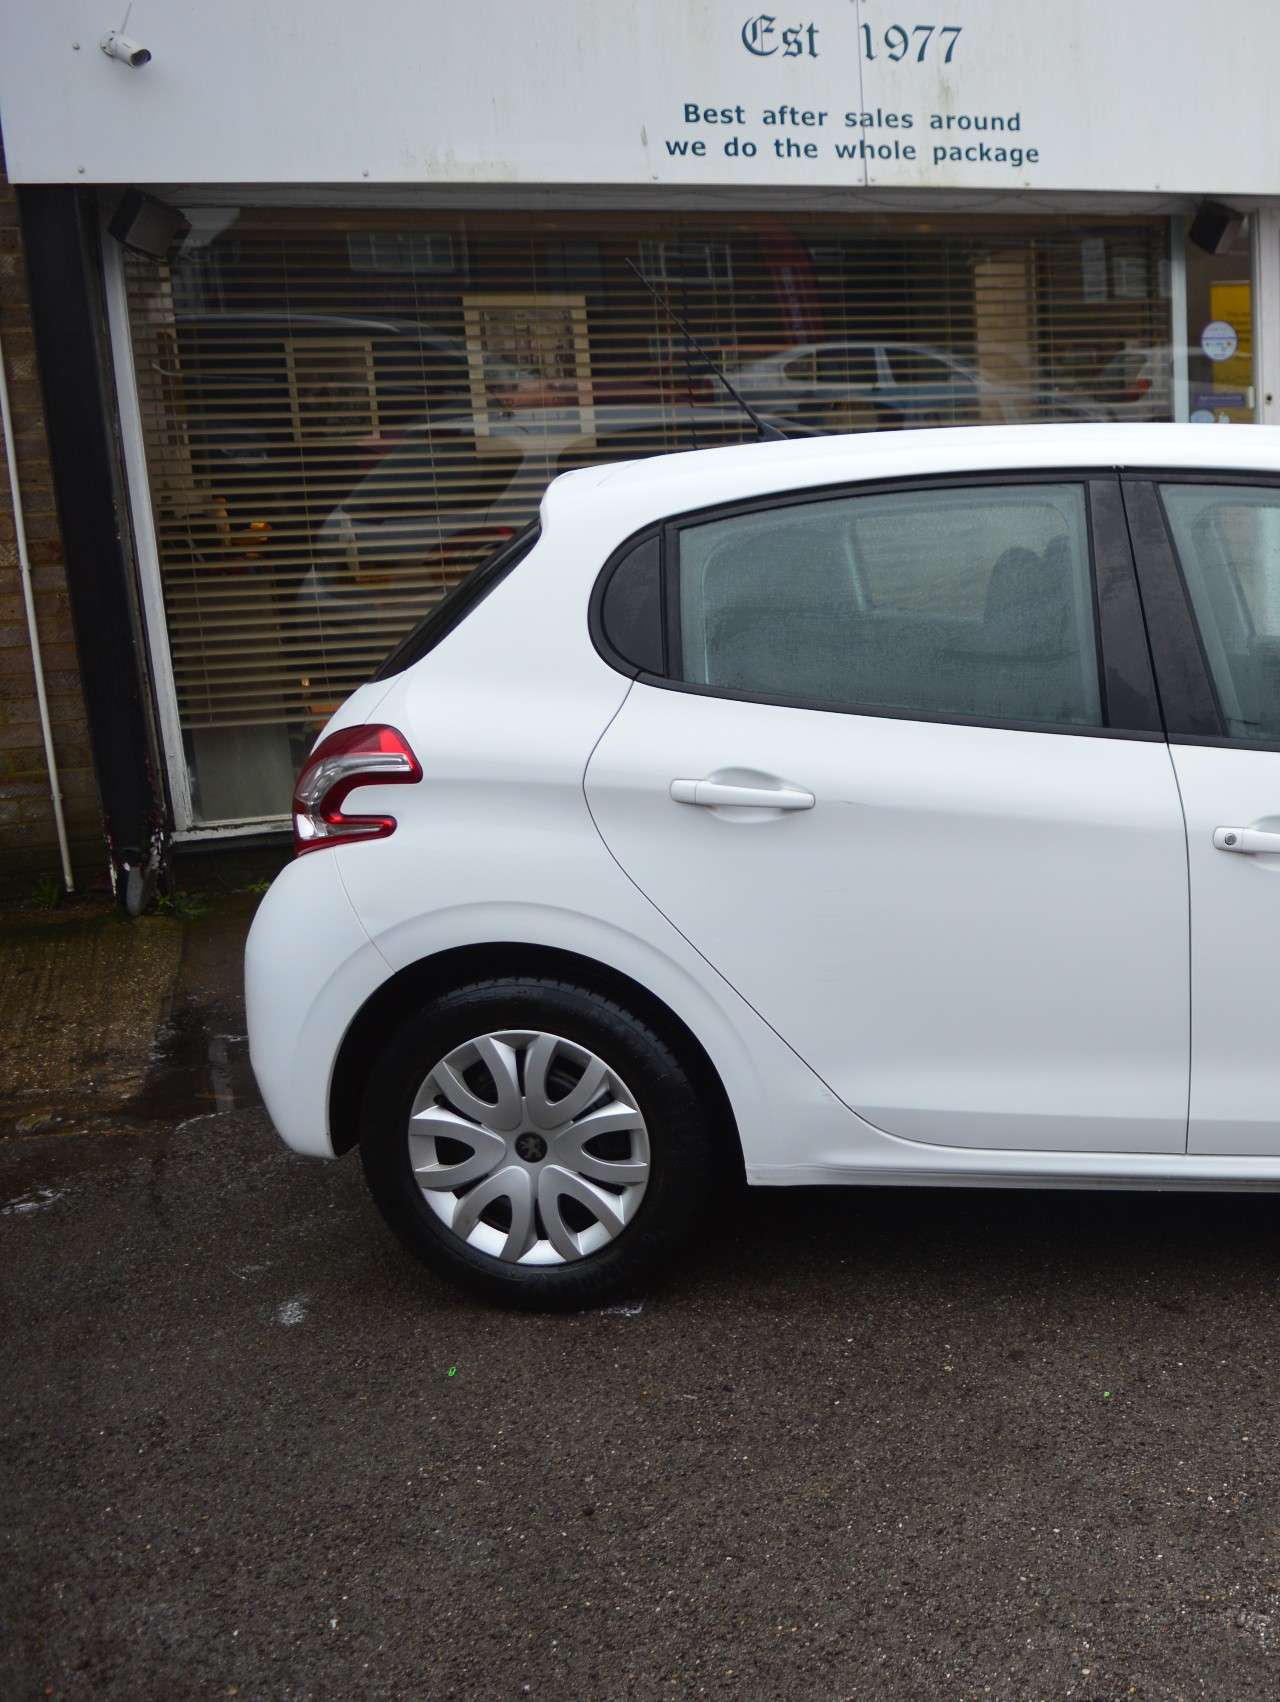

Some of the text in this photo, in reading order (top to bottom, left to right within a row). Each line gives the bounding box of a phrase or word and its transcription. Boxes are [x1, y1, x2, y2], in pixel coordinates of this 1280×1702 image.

[741, 14, 963, 64] Est 1977
[684, 103, 1021, 132] Best after sales around
[665, 137, 1040, 168] we do the whole package
